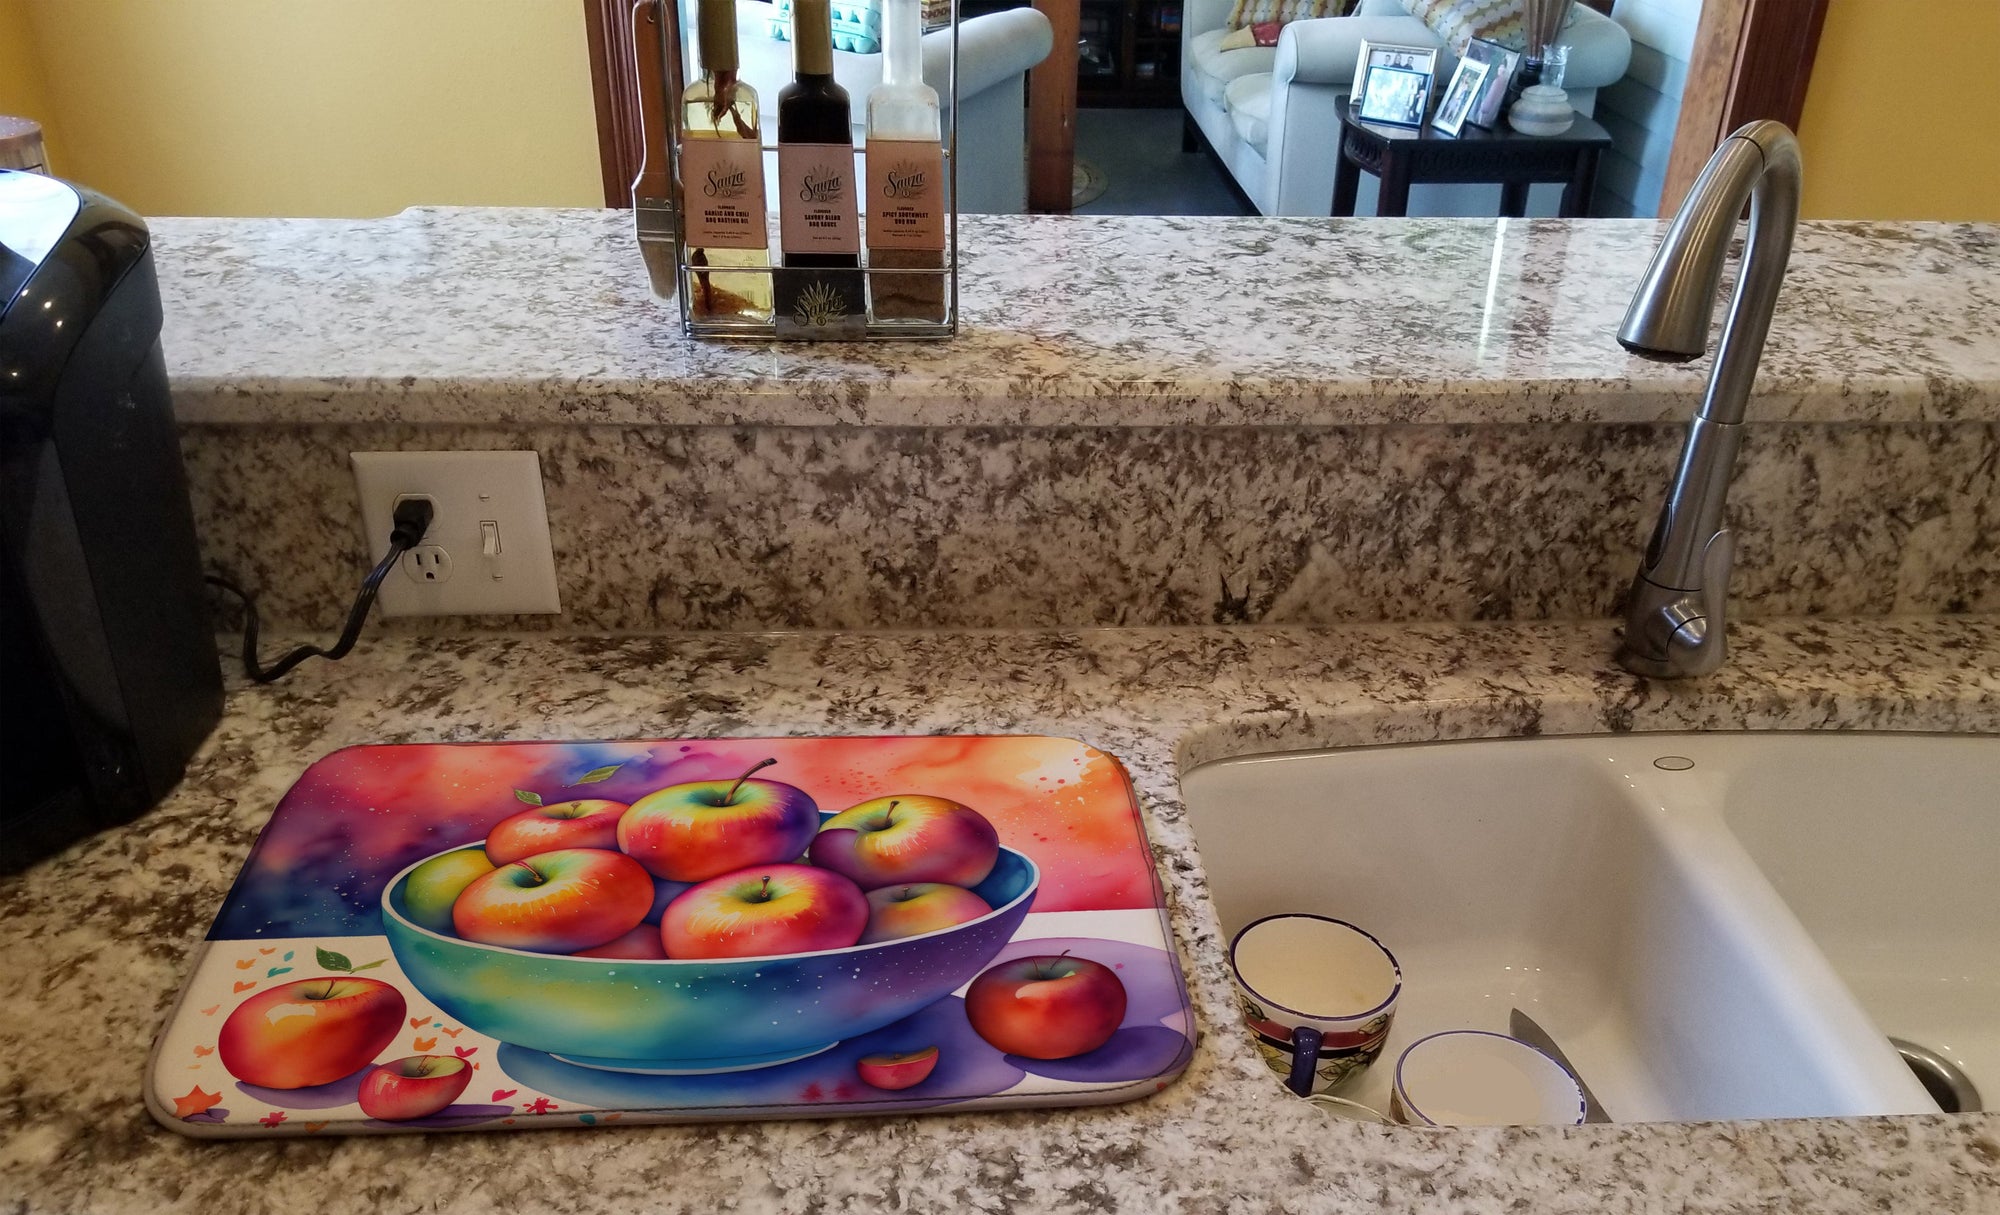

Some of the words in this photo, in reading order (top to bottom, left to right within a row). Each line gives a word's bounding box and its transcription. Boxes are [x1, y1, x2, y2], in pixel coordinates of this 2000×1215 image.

[703, 170, 746, 197] Sauza
[800, 175, 842, 202] Sauza
[883, 171, 926, 198] Sauza
